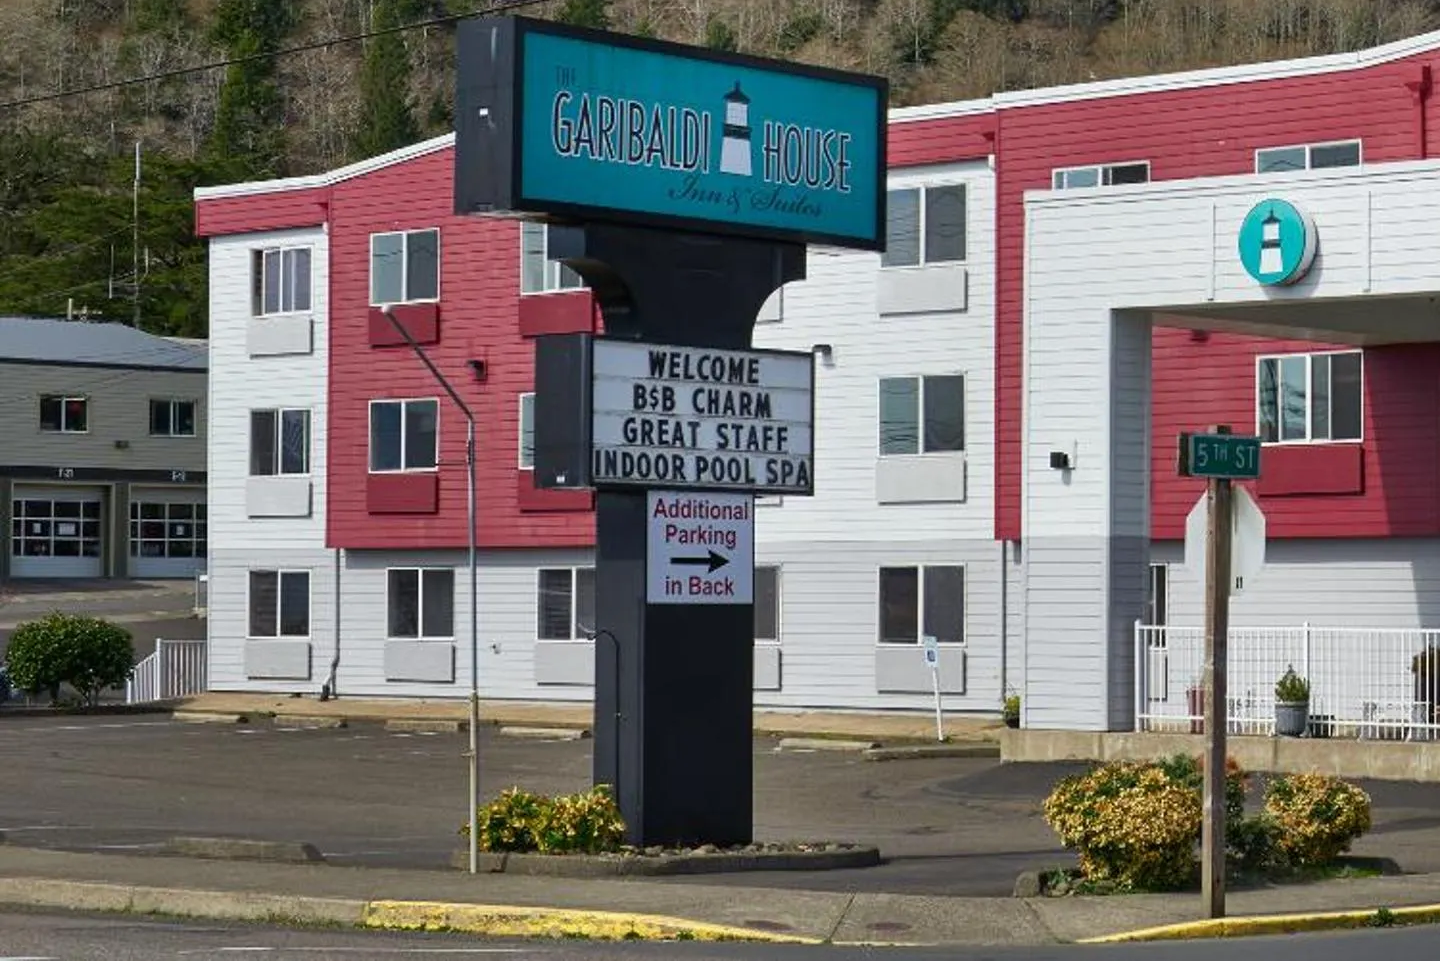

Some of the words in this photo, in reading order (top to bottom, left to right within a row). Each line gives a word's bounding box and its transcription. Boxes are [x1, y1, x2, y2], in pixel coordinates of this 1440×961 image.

[552, 90, 710, 174] GARIBALDI
[763, 120, 852, 193] HOUSE
[668, 175, 722, 206] Inn
[750, 187, 825, 218] Suites
[649, 351, 759, 384] WELCOME
[692, 388, 772, 418] CHARM
[623, 417, 700, 448] GREAT
[716, 424, 788, 452] STAFF
[595, 451, 686, 481] INDOOR
[696, 456, 756, 484] POOL
[766, 461, 810, 486] SPA
[1235, 446, 1256, 469] ST
[653, 498, 749, 520] Additional
[665, 525, 737, 550] Parking
[665, 577, 683, 596] in
[688, 576, 735, 596] Back
